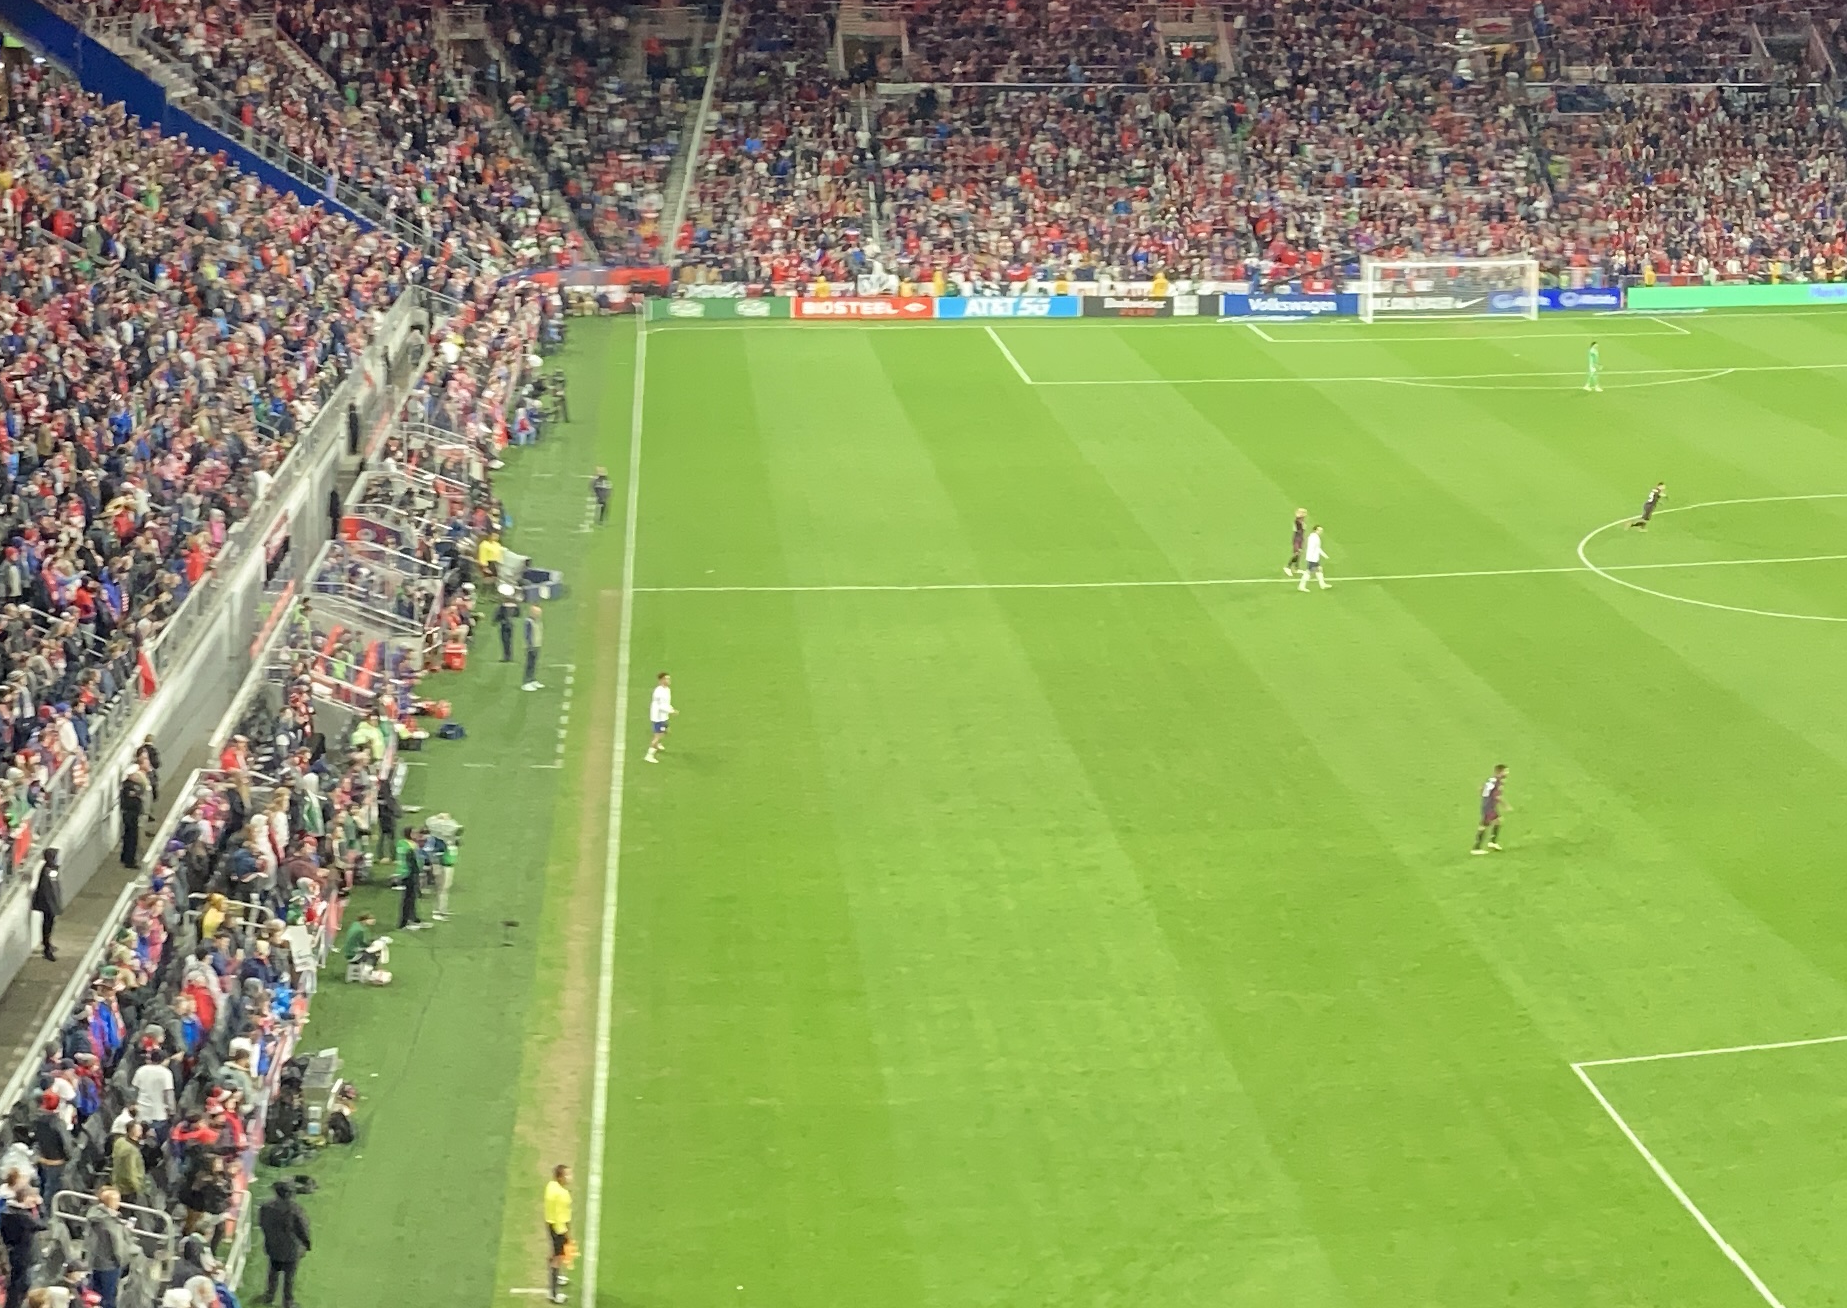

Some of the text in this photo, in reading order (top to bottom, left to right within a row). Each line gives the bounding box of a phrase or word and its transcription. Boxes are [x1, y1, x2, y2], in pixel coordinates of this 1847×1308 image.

[802, 300, 900, 316] BIOSTEEL
[964, 296, 1052, 317] AT&T 5G
[1248, 298, 1338, 314] Volkswagen
